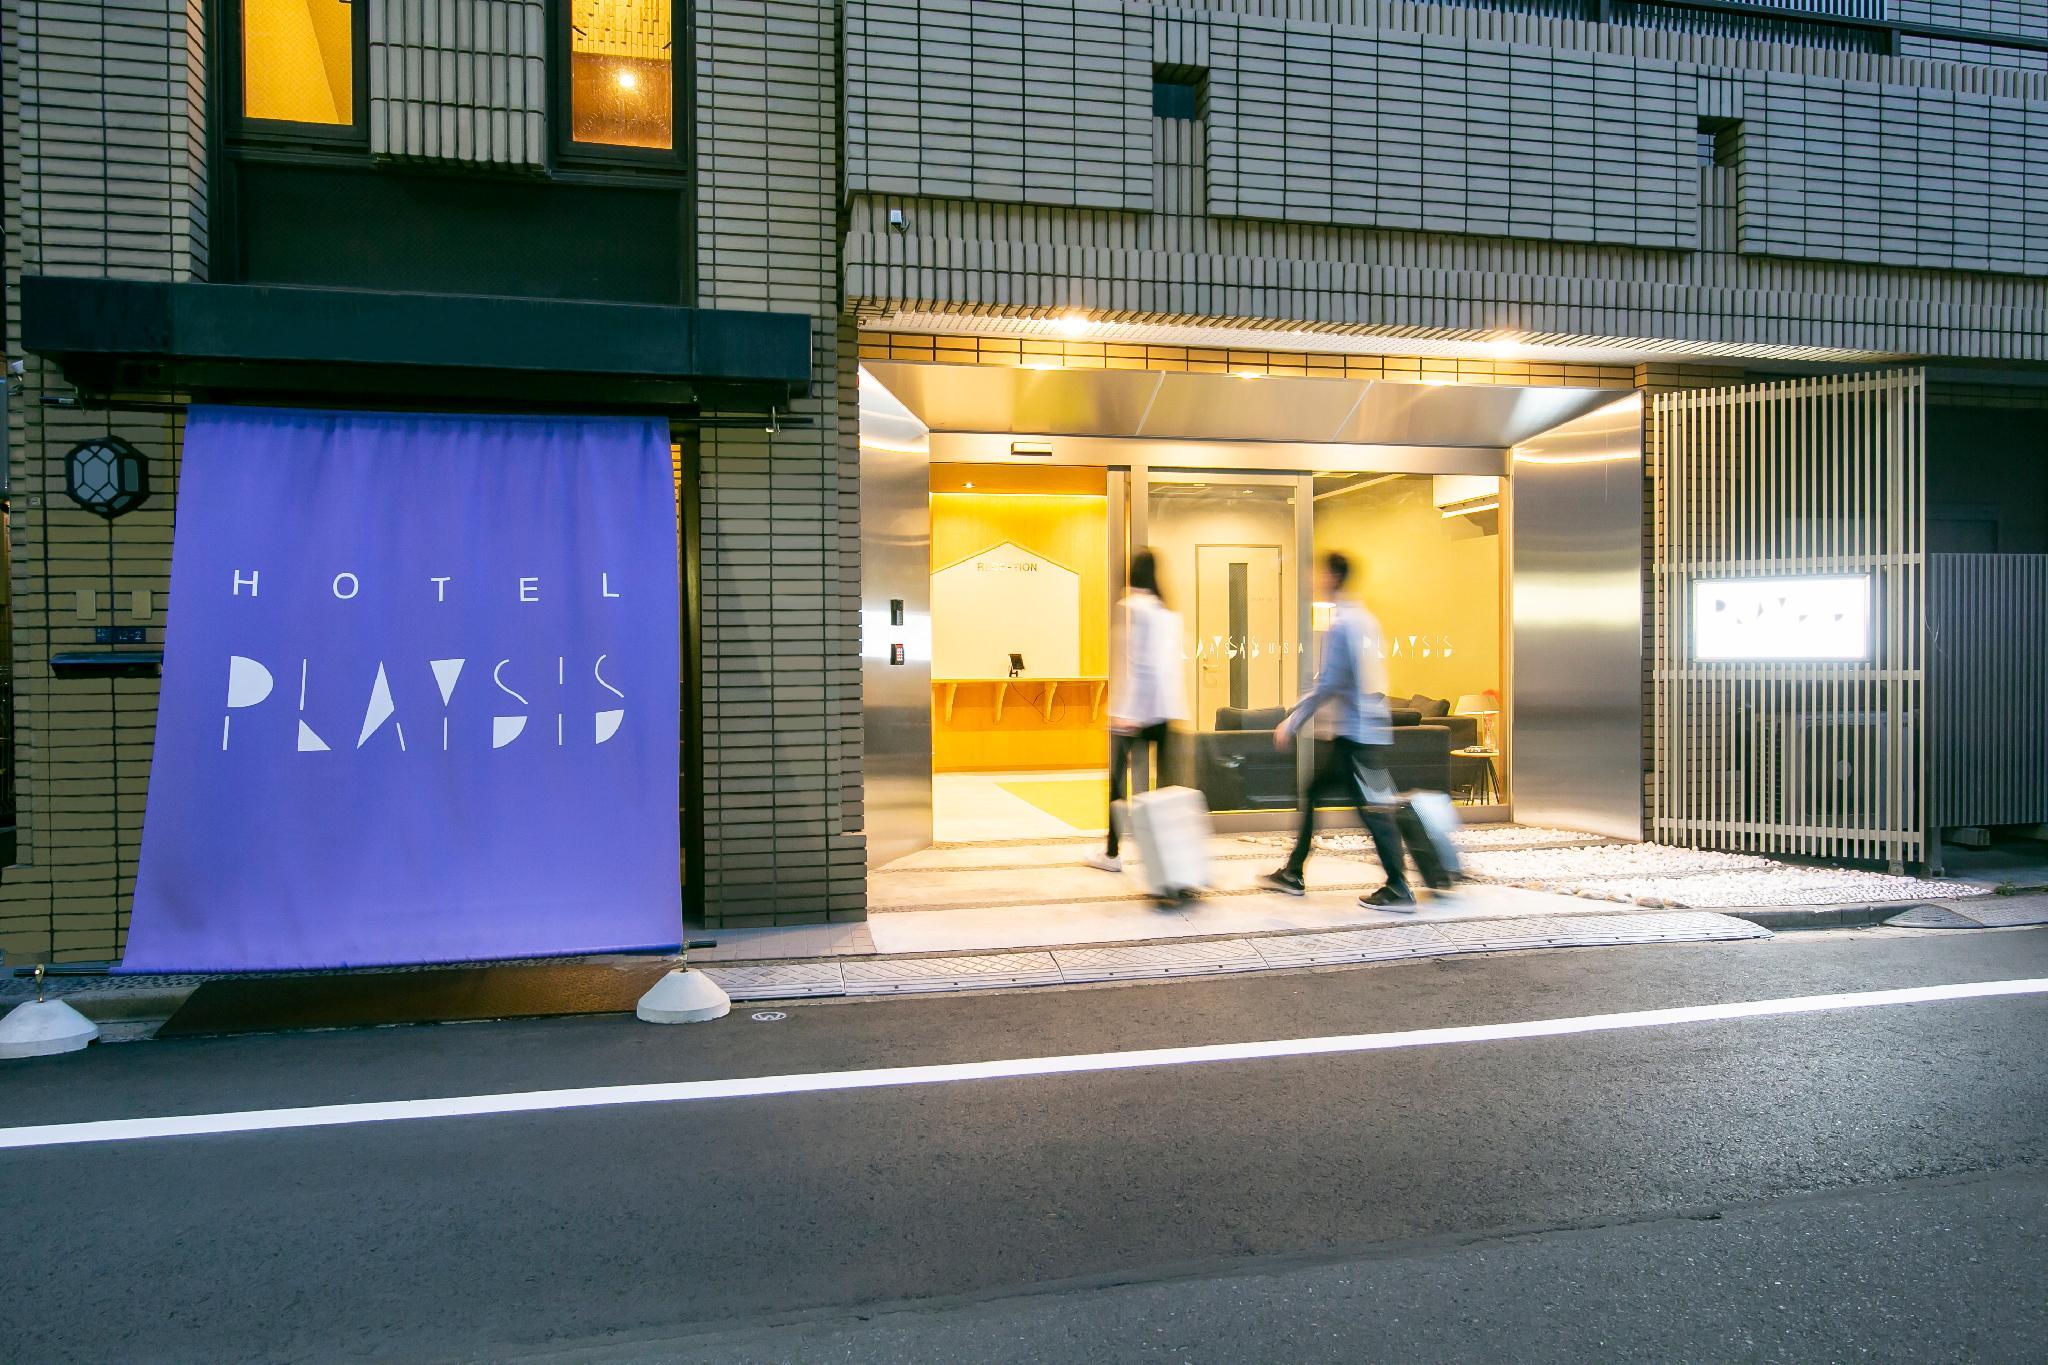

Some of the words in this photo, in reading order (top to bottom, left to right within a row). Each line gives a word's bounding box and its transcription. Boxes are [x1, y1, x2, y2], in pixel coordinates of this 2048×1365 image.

[977, 562, 1037, 572] RETION
[232, 569, 620, 602] HOTEL
[1178, 635, 1261, 660] LAYSIS
[222, 654, 625, 752] PLAYSIS
